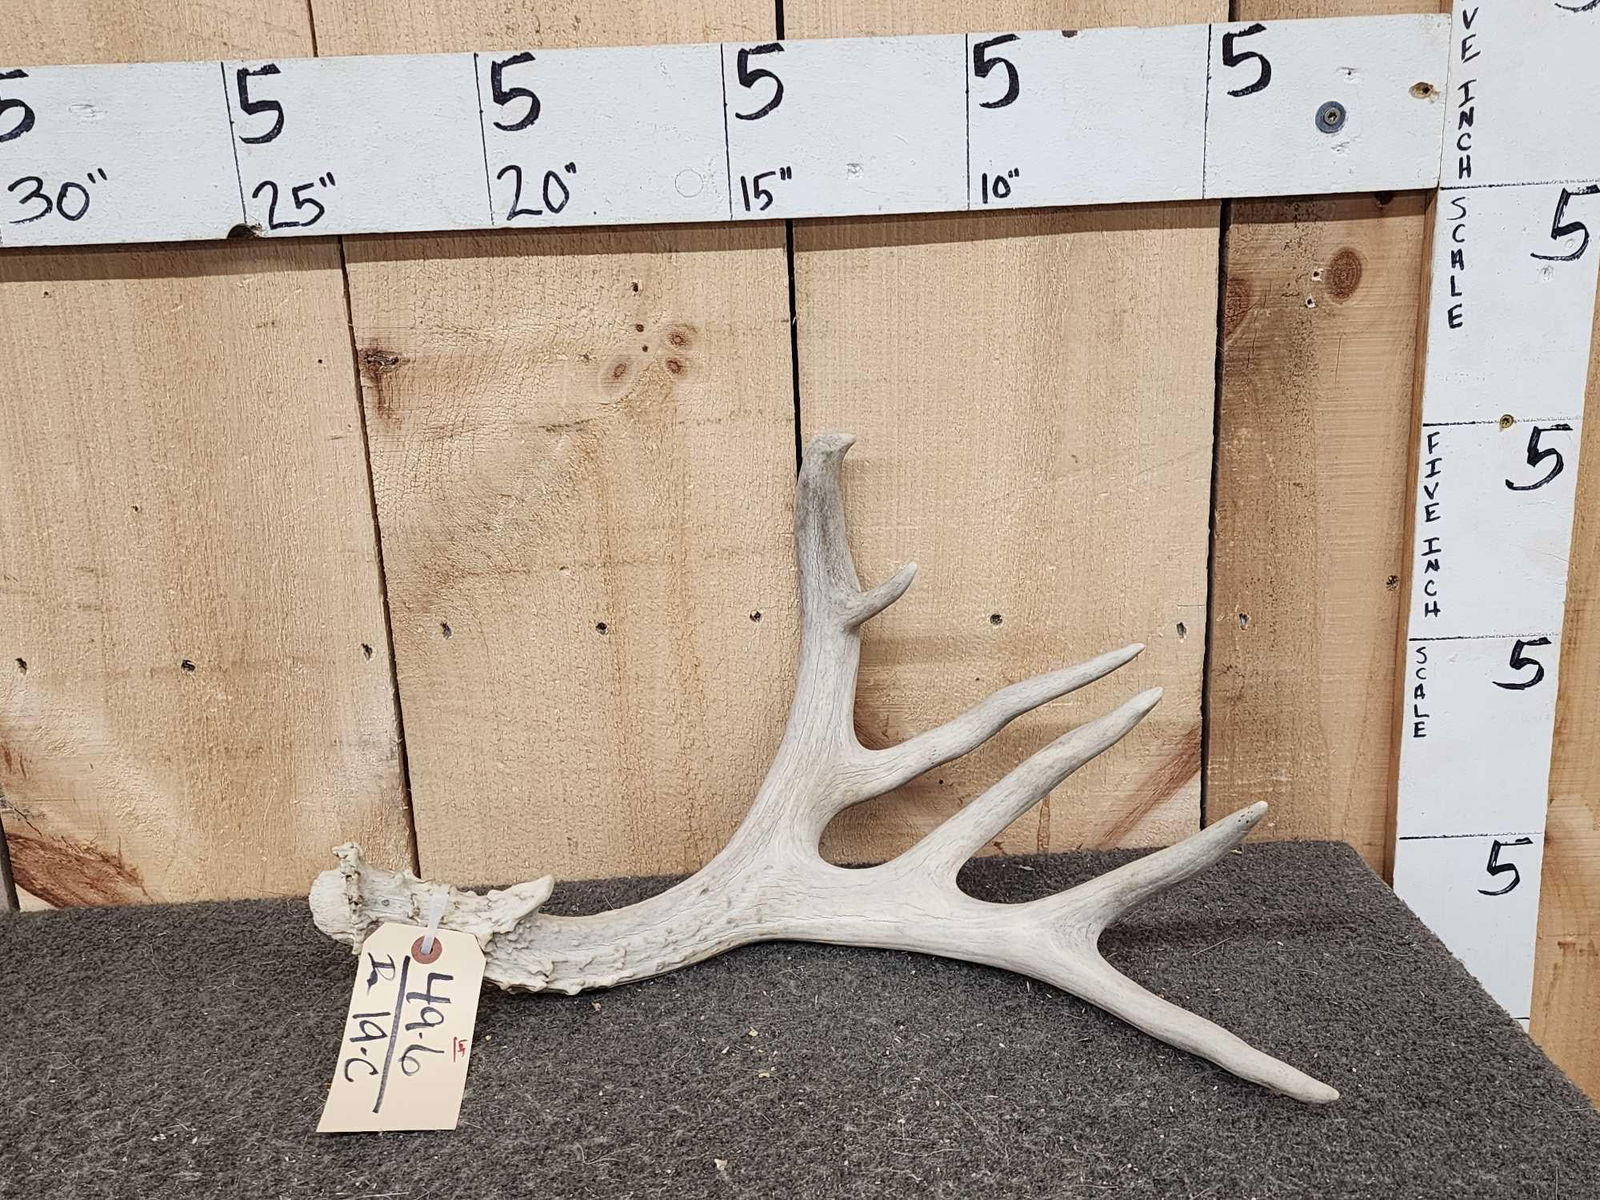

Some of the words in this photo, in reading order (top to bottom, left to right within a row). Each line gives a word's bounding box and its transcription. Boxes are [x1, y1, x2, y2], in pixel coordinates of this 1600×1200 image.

[490, 52, 541, 131] 5
[735, 42, 784, 121] 5
[973, 34, 1020, 109] 5
[1222, 23, 1272, 97] 5
[237, 63, 284, 143] 5
[1457, 78, 1477, 179] INCH
[8, 168, 108, 224] 30"
[251, 171, 335, 229] 25"
[496, 162, 577, 221] 20"
[740, 166, 792, 212] 15"
[982, 167, 1020, 203] 10"
[1530, 184, 1600, 261] 5
[1447, 196, 1467, 329] SCALE
[1424, 431, 1440, 522] FIVE
[1505, 423, 1573, 490] 5
[1421, 537, 1441, 617] INCH
[1413, 647, 1430, 738] SCALE
[1492, 637, 1552, 690] 5
[1477, 837, 1533, 896] 5
